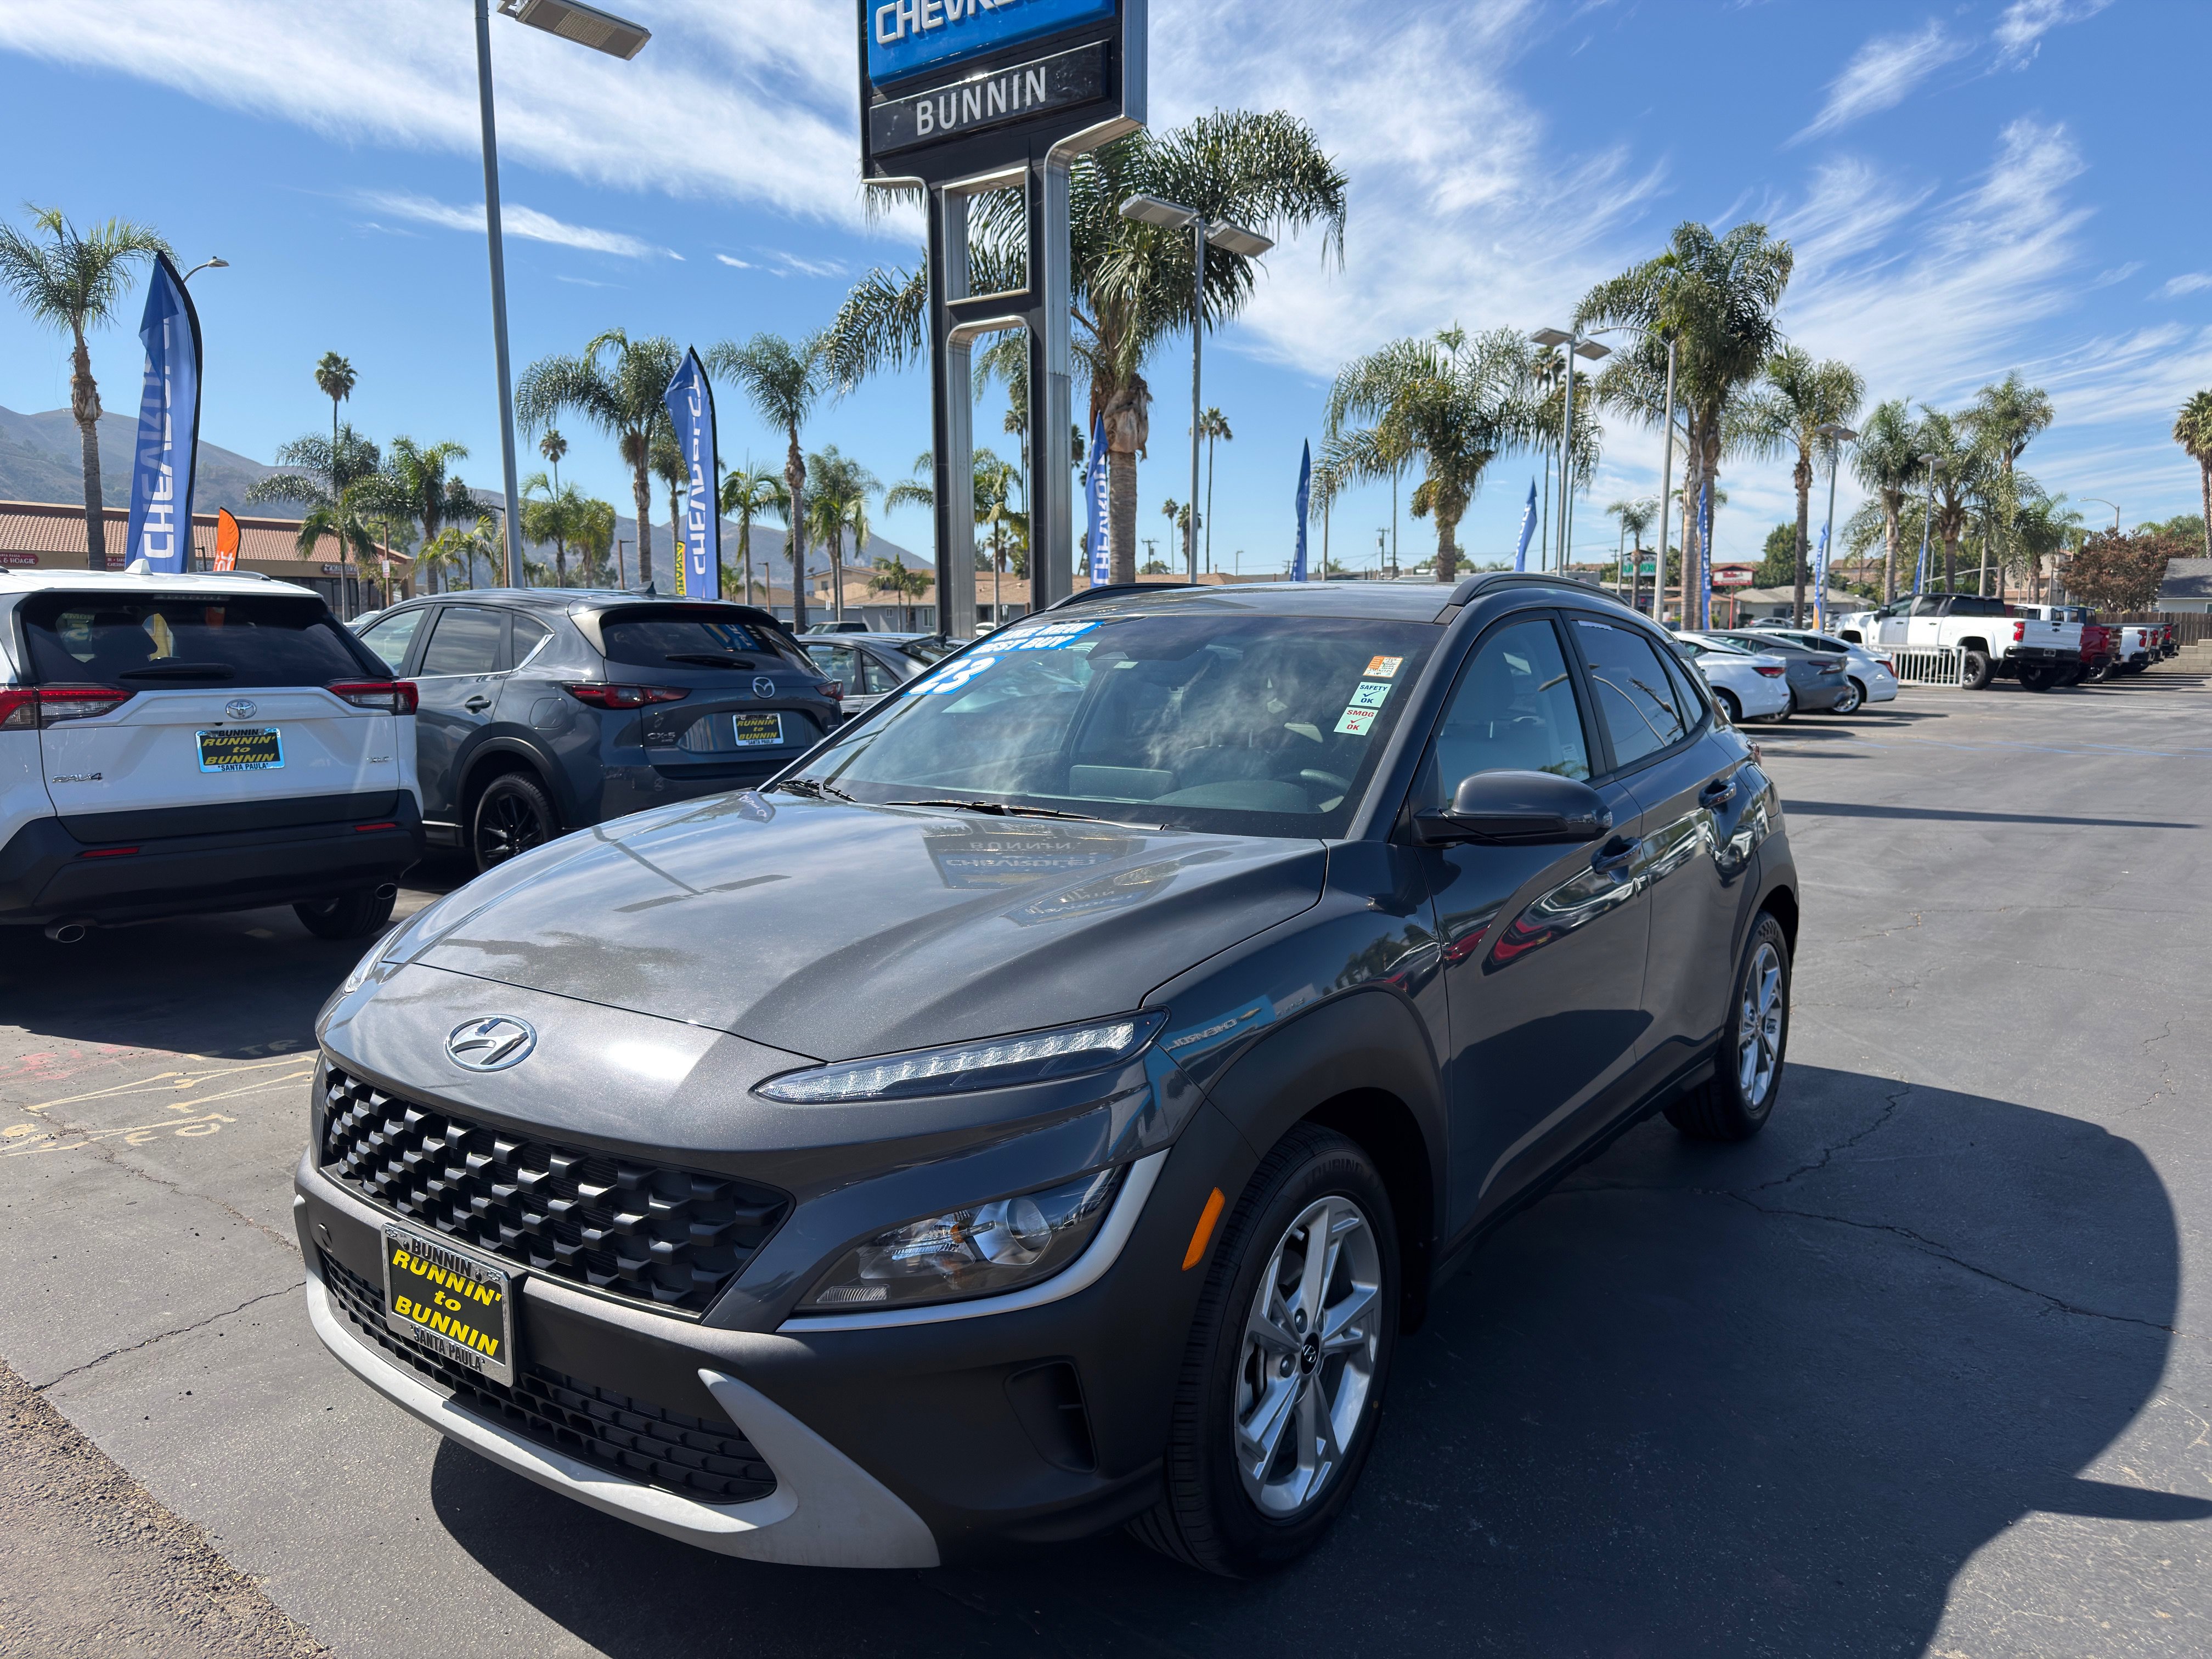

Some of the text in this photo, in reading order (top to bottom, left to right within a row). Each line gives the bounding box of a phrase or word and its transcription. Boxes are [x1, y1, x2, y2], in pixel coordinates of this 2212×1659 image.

[876, 0, 1016, 43] CHEV
[916, 66, 1046, 136] BUNNIN
[969, 636, 1075, 655] BEST BUY
[992, 623, 1096, 641] LIKE NEW
[909, 657, 996, 694] 23
[202, 736, 275, 746] RUNNIN'
[205, 753, 275, 765] BUNNIN
[53, 772, 103, 783] RAV4
[411, 1237, 472, 1277] BUNNIN
[392, 1249, 502, 1306] RUNNIN'
[434, 1290, 461, 1311] to
[394, 1295, 499, 1356] BUNNIN
[414, 1325, 482, 1372] SANTA PAULA
